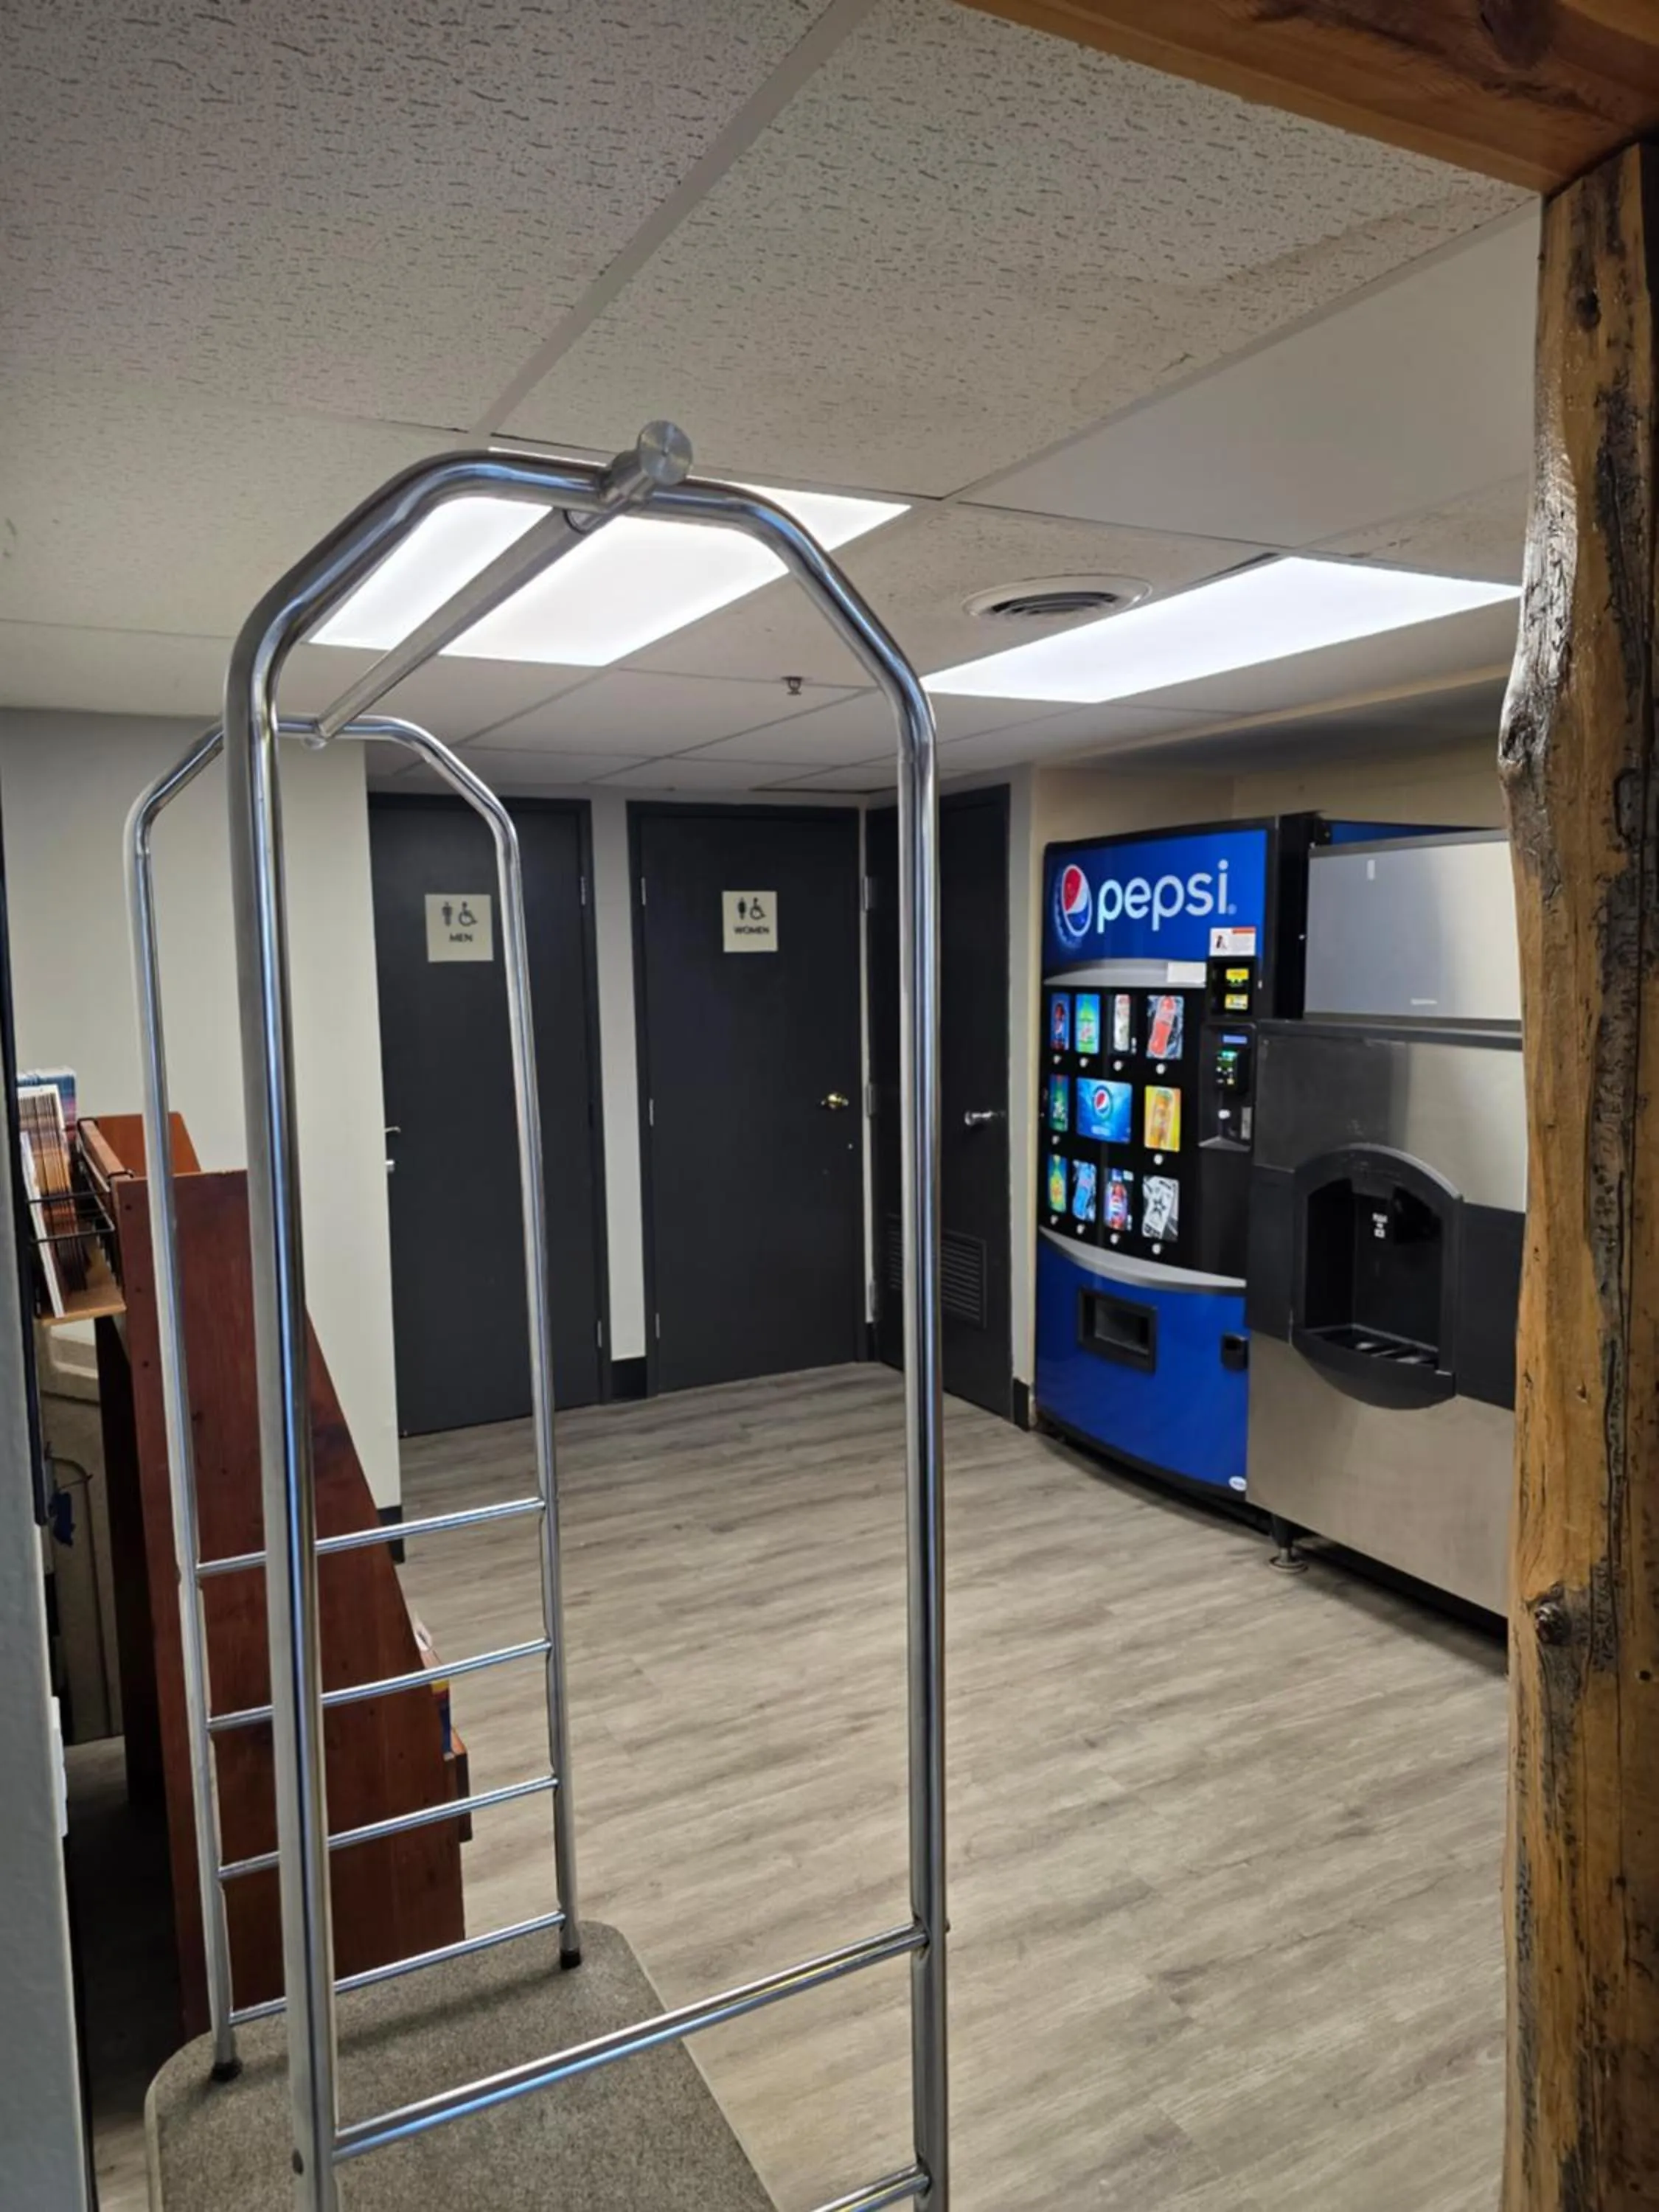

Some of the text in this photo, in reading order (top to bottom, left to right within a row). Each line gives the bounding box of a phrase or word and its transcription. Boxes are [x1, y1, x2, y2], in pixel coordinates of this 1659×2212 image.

[1097, 859, 1228, 933] pepsi
[734, 925, 770, 934] WOMEN
[449, 933, 473, 942] MEN
